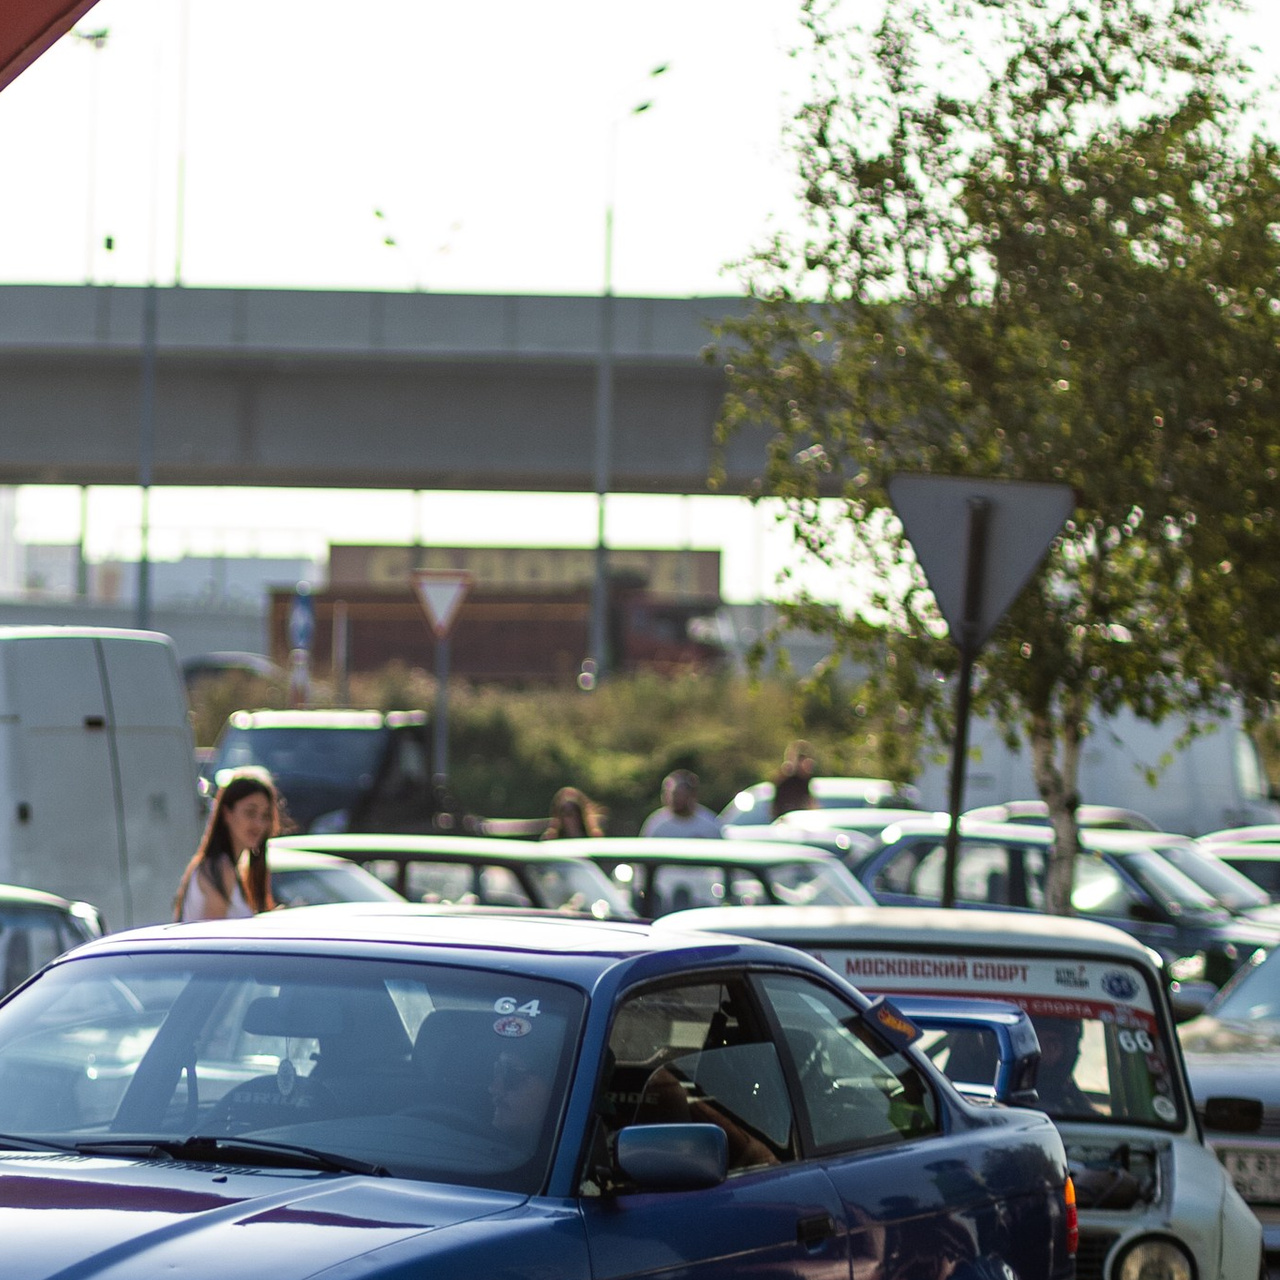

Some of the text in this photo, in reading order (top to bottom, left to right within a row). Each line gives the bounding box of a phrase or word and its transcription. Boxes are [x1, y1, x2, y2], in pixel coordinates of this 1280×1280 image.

[845, 956, 969, 980] МОСКОВСКИЙ
[972, 962, 1030, 983] СПОРТ
[493, 996, 541, 1018] 64
[1119, 1029, 1154, 1054] 66
